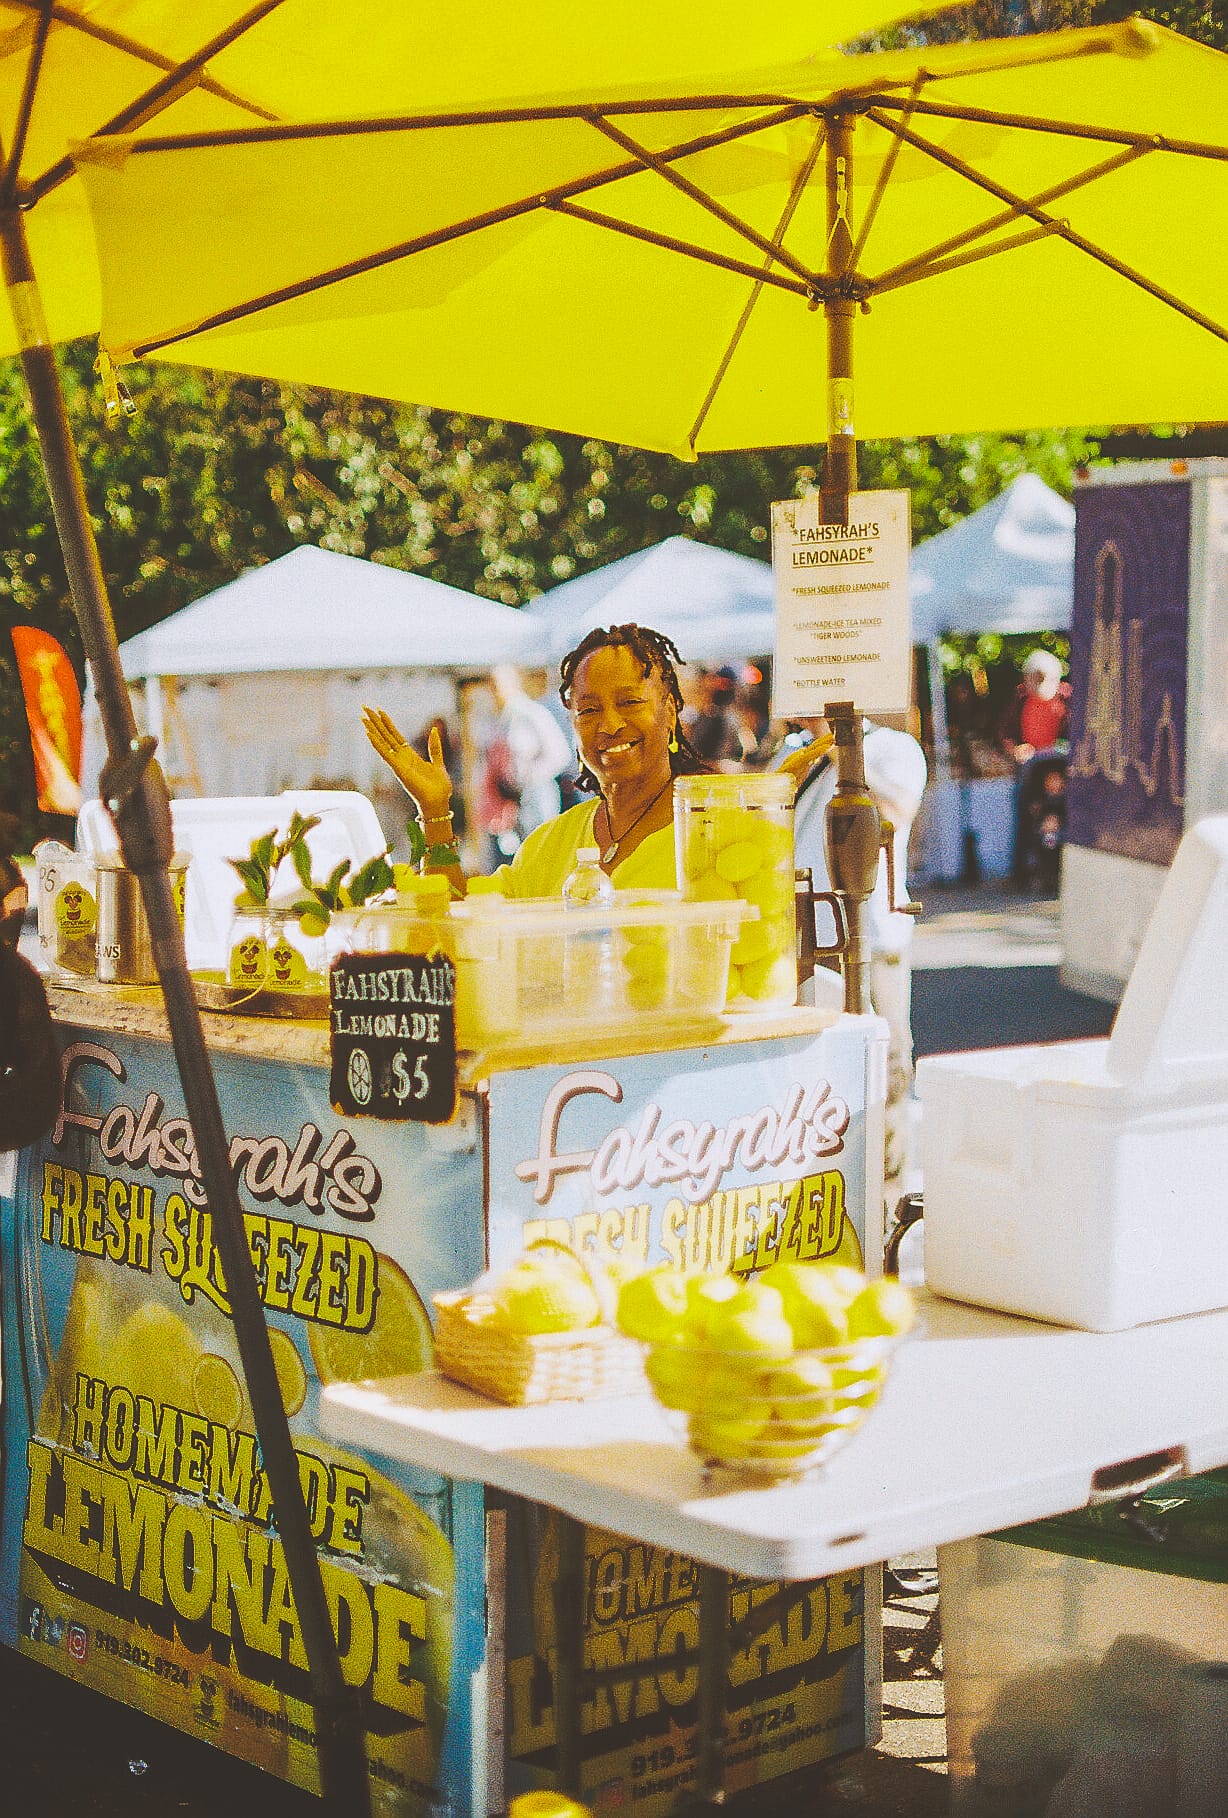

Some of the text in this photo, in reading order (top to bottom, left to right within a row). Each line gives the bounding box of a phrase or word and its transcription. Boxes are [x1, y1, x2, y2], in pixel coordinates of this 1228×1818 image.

[817, 584, 851, 594] SQUEEZED
[843, 652, 880, 662] LEMONADE
[821, 678, 846, 687] WATER
[332, 1009, 441, 1044] LEMONADE
[391, 1047, 430, 1106] $5
[40, 1161, 156, 1274] FRESH
